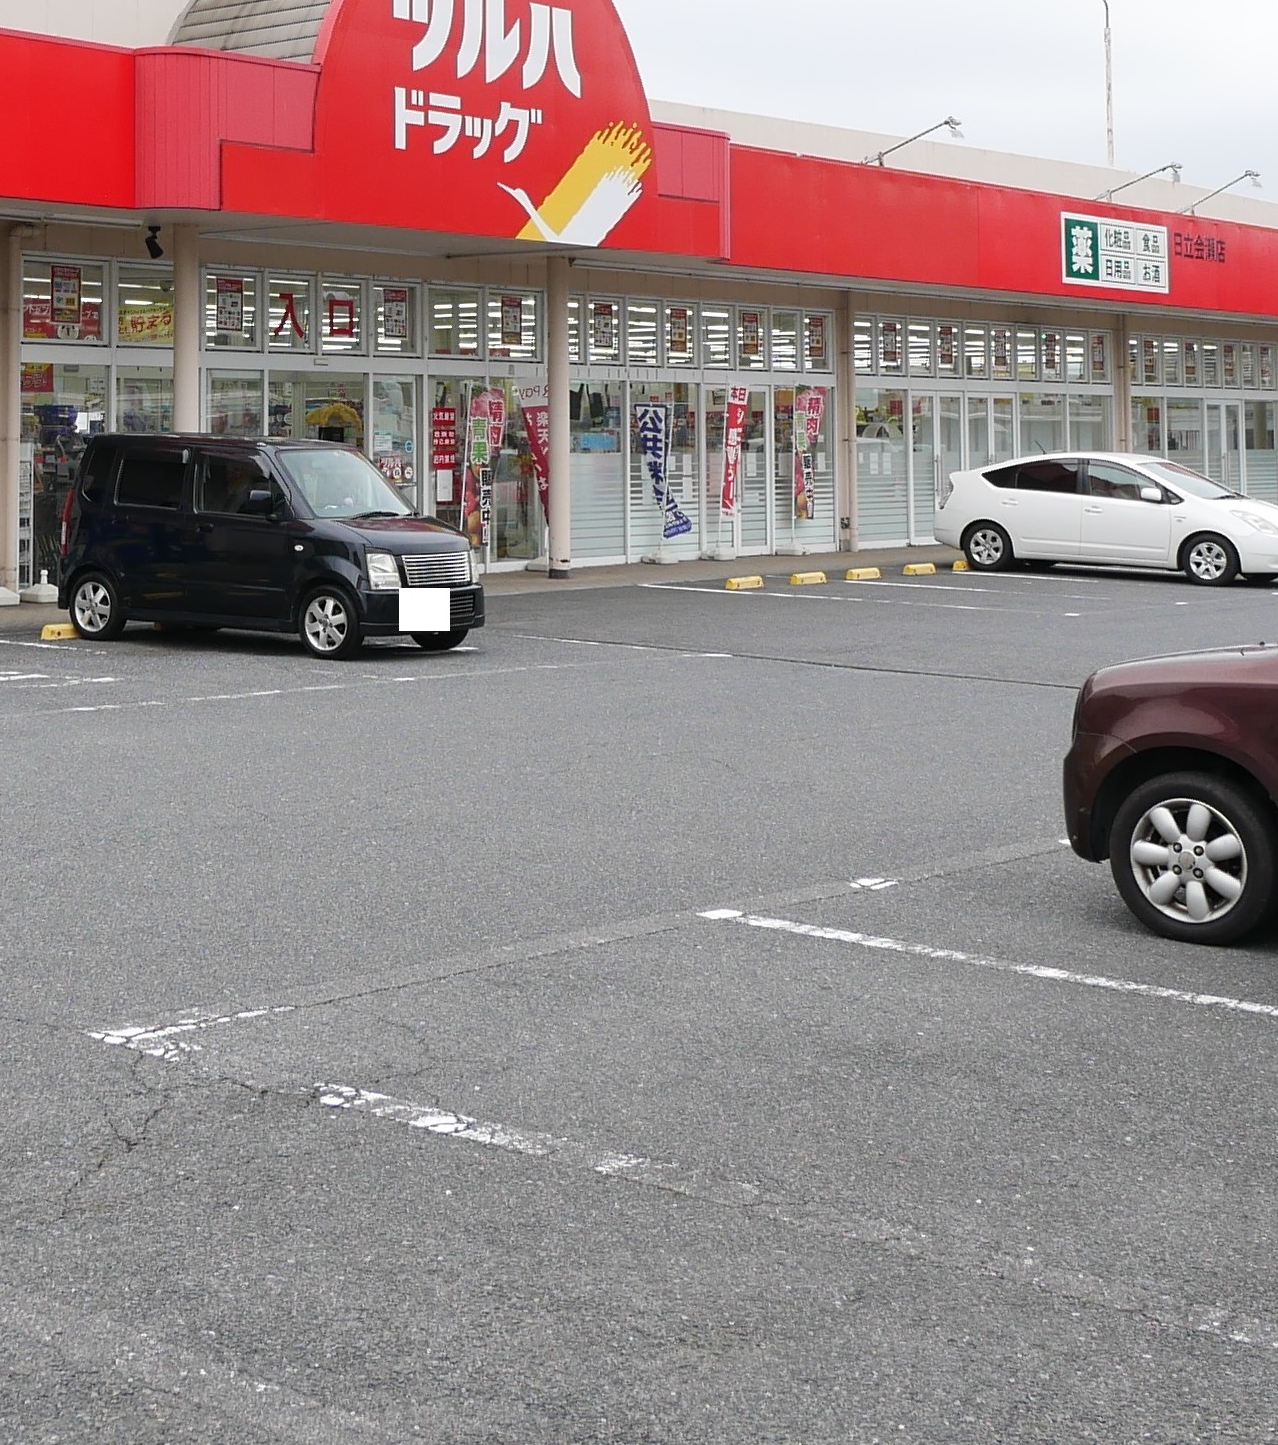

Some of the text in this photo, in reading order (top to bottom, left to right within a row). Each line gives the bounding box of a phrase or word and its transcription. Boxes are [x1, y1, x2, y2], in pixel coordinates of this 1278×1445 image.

[393, 86, 543, 164] ドラッグ
[1070, 225, 1094, 274] 薬
[1105, 228, 1132, 251] 化粧品
[1142, 233, 1160, 254] 食品
[1106, 259, 1132, 280] 日用品
[1142, 263, 1161, 284] お酒
[273, 292, 354, 338] 入口
[471, 416, 489, 465] 青果
